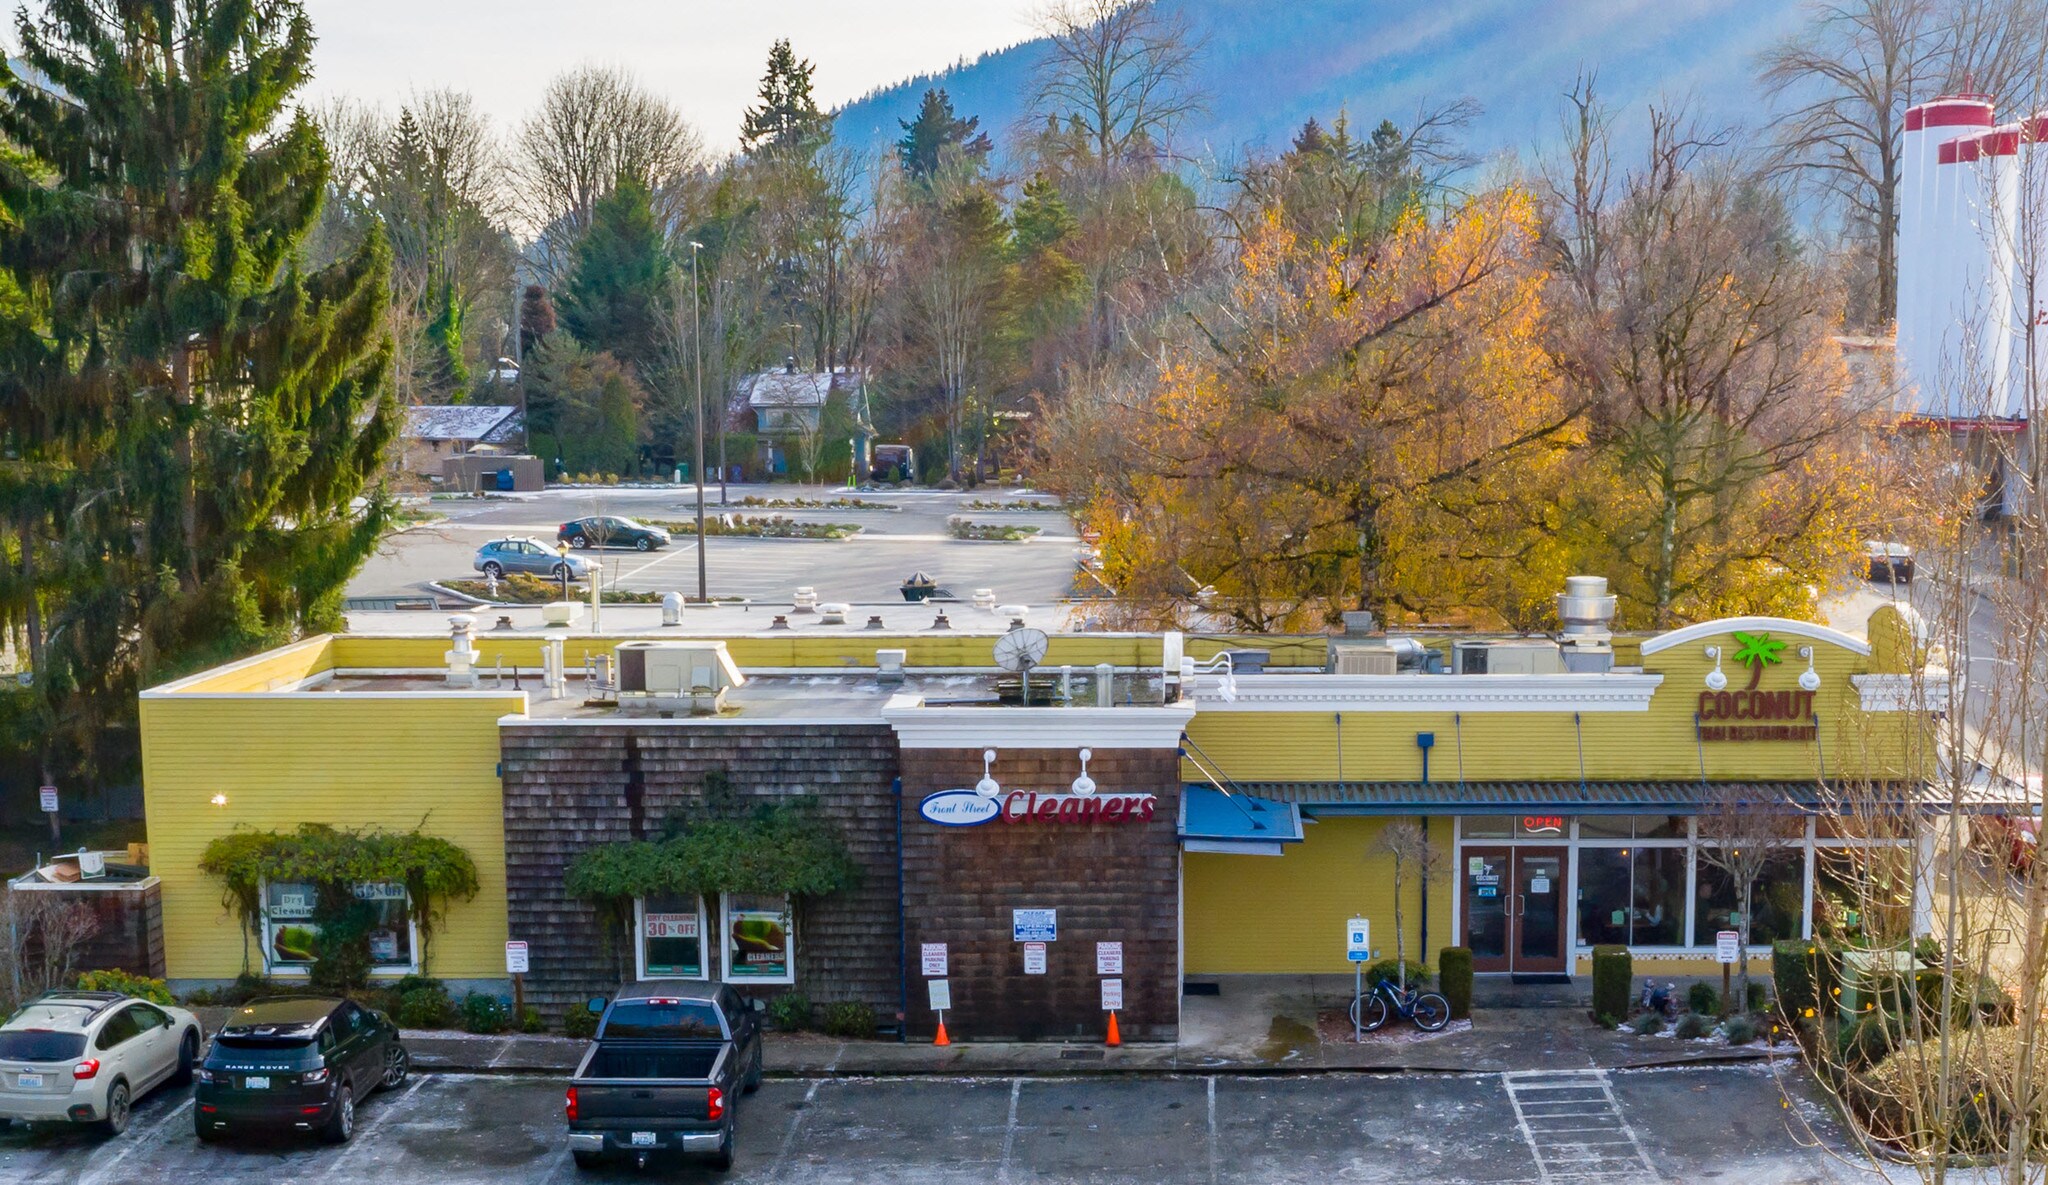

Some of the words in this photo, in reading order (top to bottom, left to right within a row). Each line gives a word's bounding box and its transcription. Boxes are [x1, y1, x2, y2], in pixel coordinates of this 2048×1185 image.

[1699, 690, 1817, 720] COCONUT
[1699, 726, 1726, 741] THAI
[1729, 726, 1816, 741] RESTAURANT
[929, 801, 956, 814] Front
[961, 801, 991, 813] Street
[1002, 789, 1158, 825] Cleaners
[1523, 815, 1562, 829] OPEN
[283, 895, 303, 906] Dry
[271, 906, 313, 915] Cleanin
[647, 914, 661, 922] DRY
[663, 914, 695, 922] CLEANING
[677, 923, 695, 935] OFF
[747, 952, 785, 962] CLEANERS
